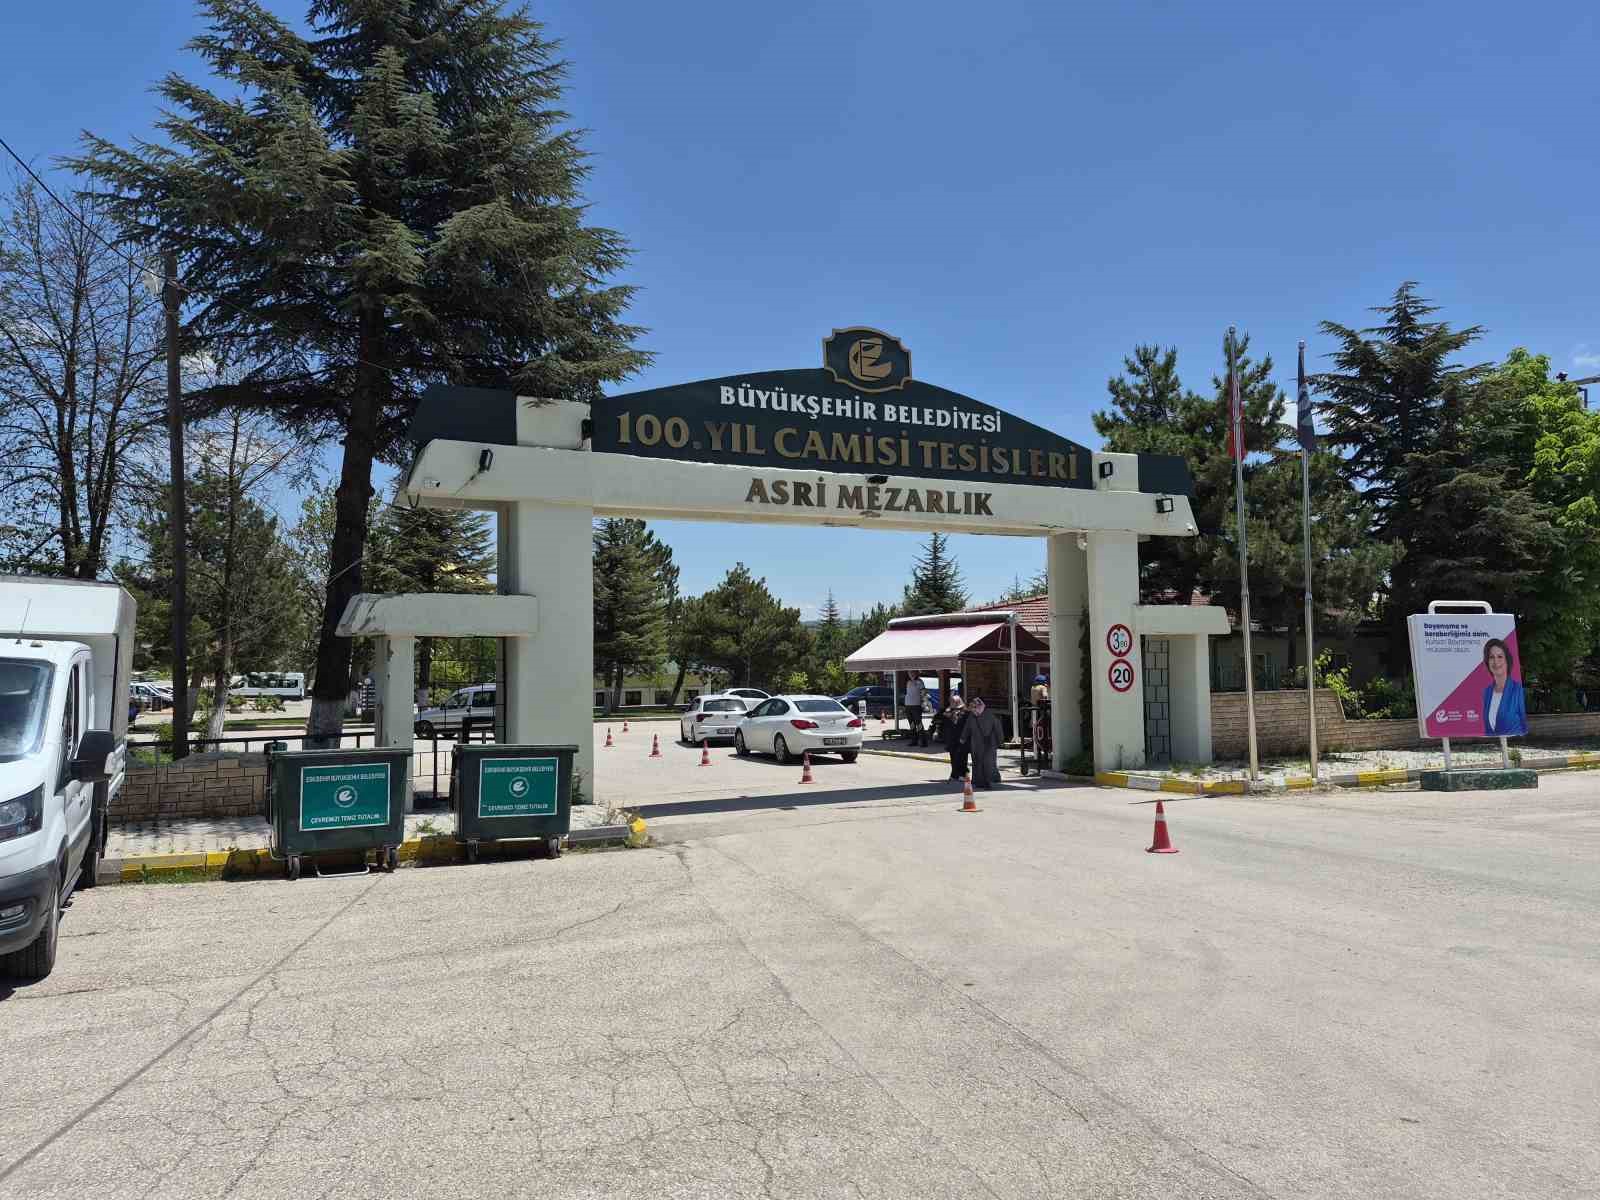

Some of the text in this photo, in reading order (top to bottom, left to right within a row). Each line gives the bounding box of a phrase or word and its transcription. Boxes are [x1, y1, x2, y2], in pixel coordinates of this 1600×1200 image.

[720, 383, 1001, 433] BÜYÜKŞEHİR BELEDİYESİ
[774, 426, 912, 468] CAMİSİ
[918, 437, 1078, 481] TESİSLERİ
[744, 475, 995, 517] ASRİ MEZARLIK
[1113, 668, 1130, 683] 20
